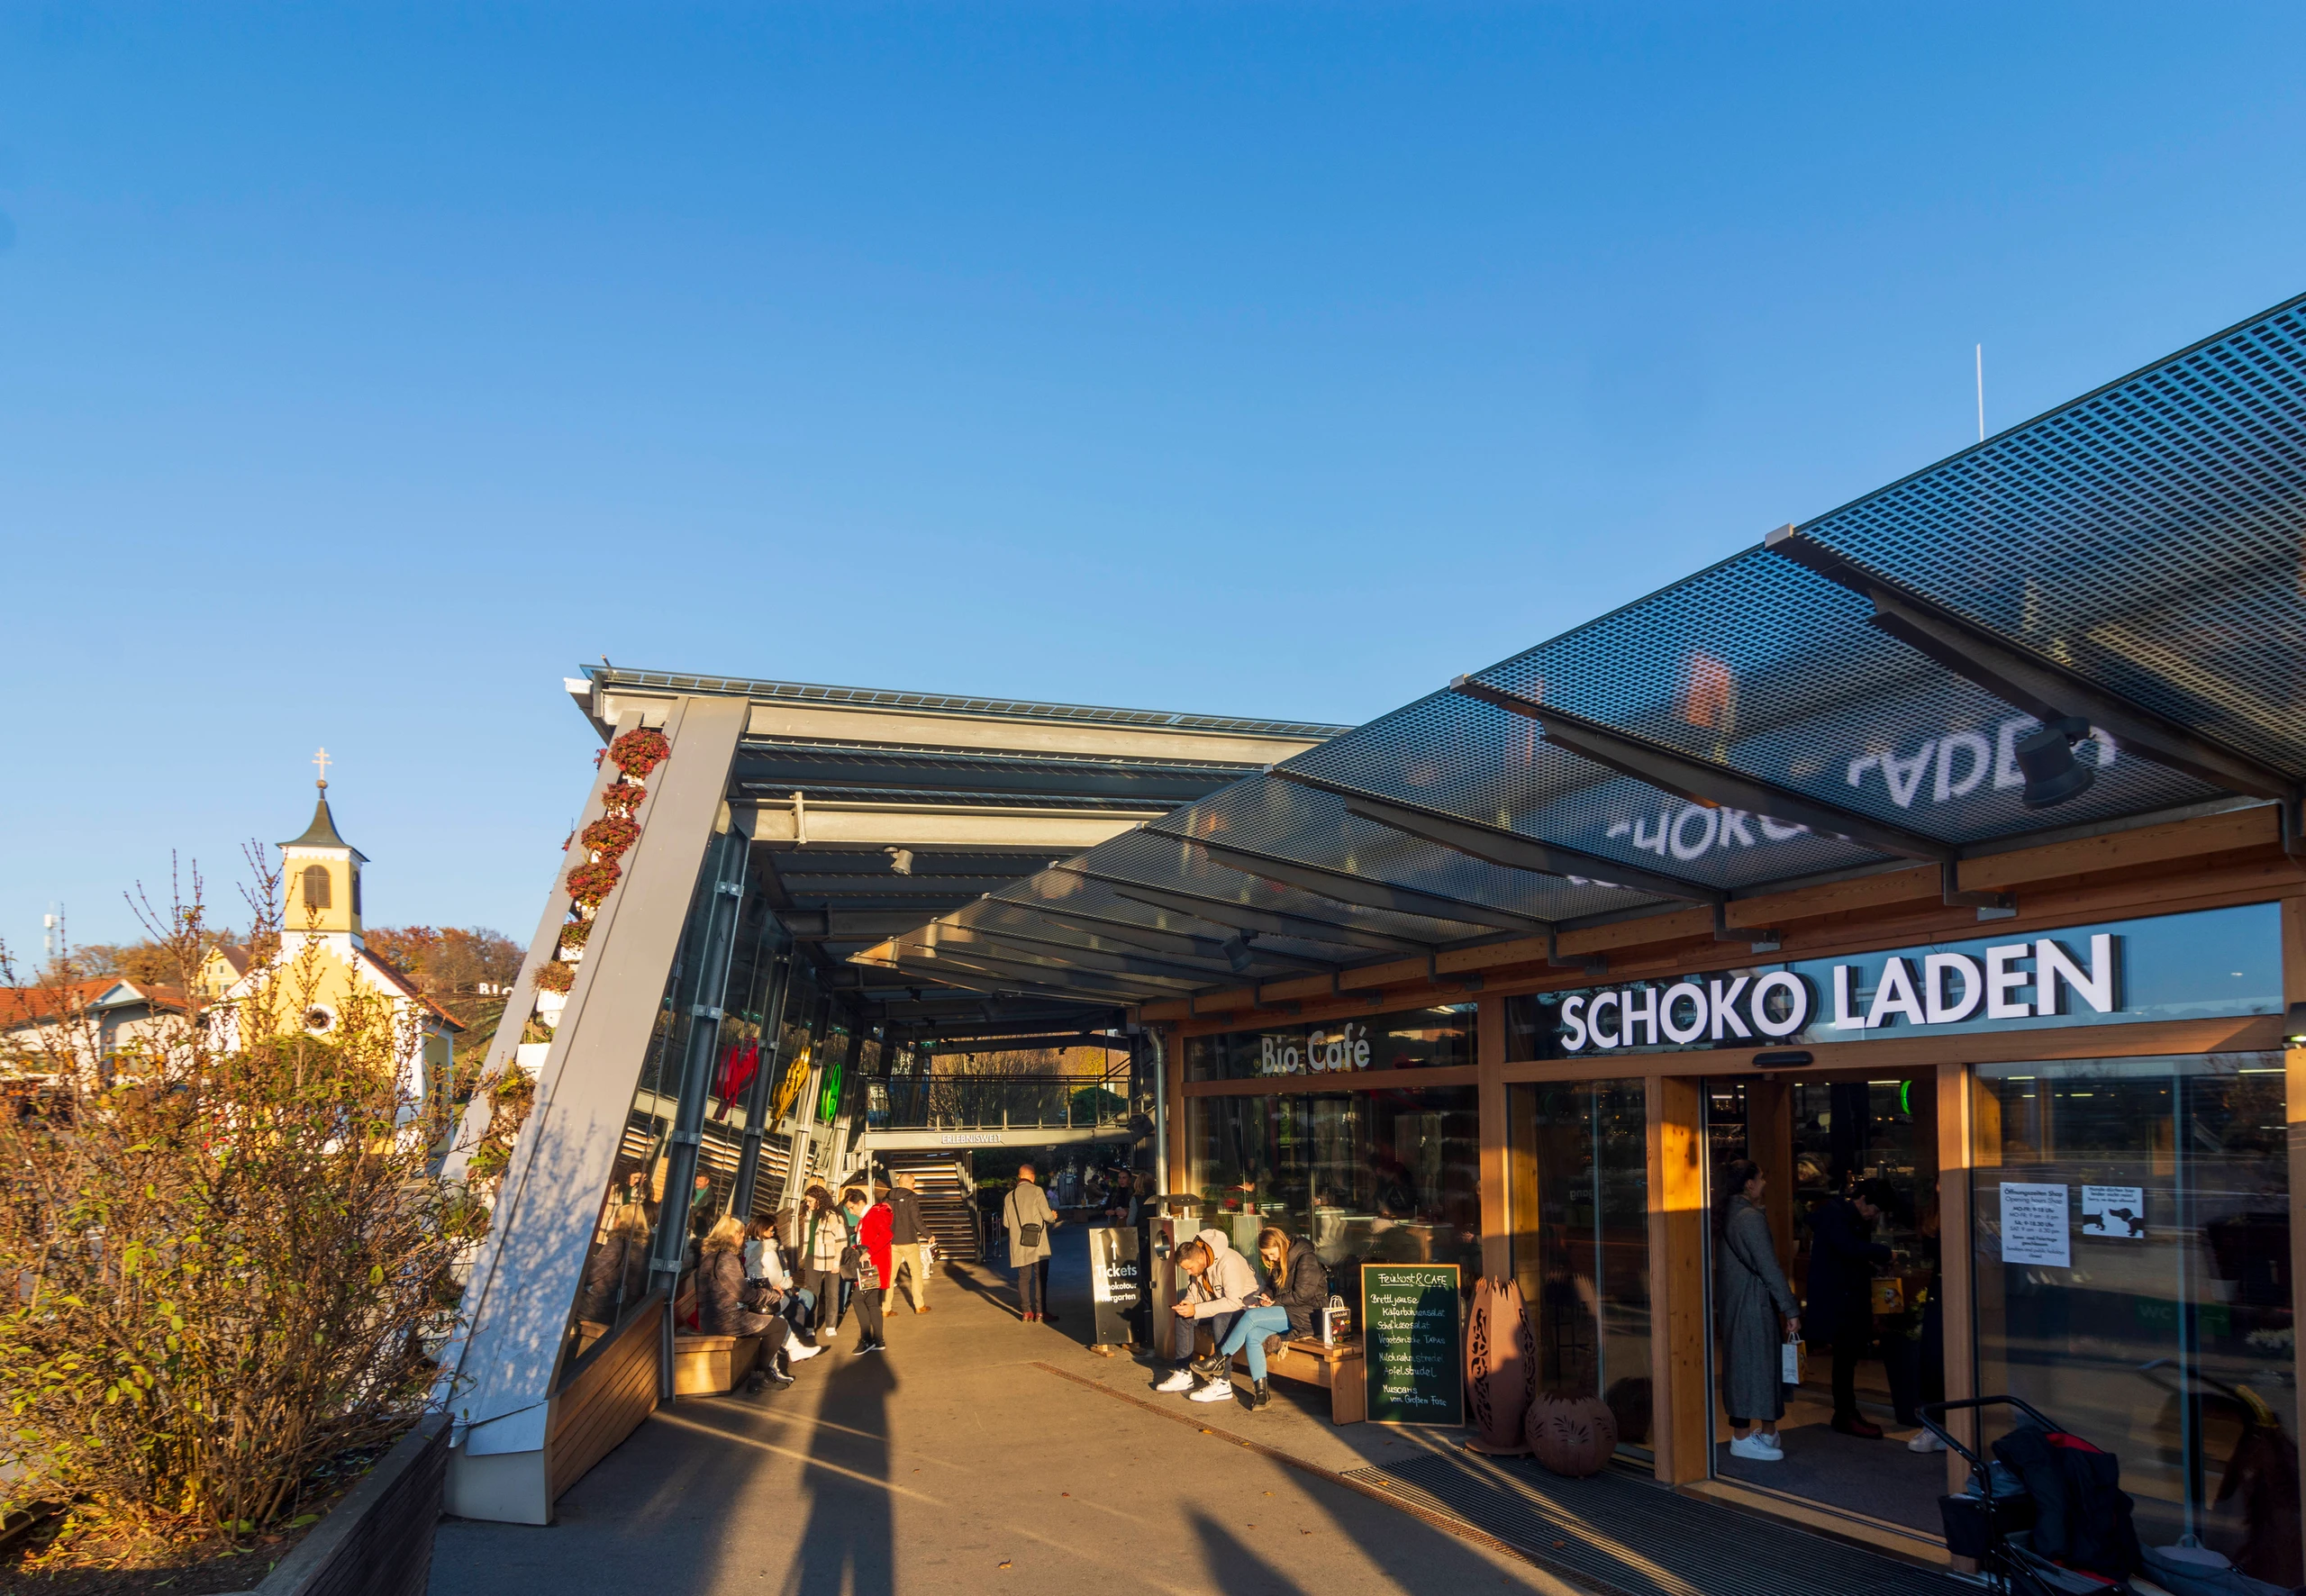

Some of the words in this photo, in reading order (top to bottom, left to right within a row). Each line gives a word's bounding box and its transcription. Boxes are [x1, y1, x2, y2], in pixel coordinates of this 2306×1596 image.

[1560, 971, 1807, 1051] SCHOKO
[1833, 933, 2117, 1030] LADEN
[1261, 1035, 1299, 1074] Bio
[1308, 1022, 1371, 1071] Café
[941, 1134, 1002, 1144] ERLEBNISWELT
[2005, 1195, 2030, 1203] Opening
[2047, 1190, 2064, 1198] Shop
[1095, 1262, 1138, 1278] Tickets
[2138, 1304, 2174, 1321] WC
